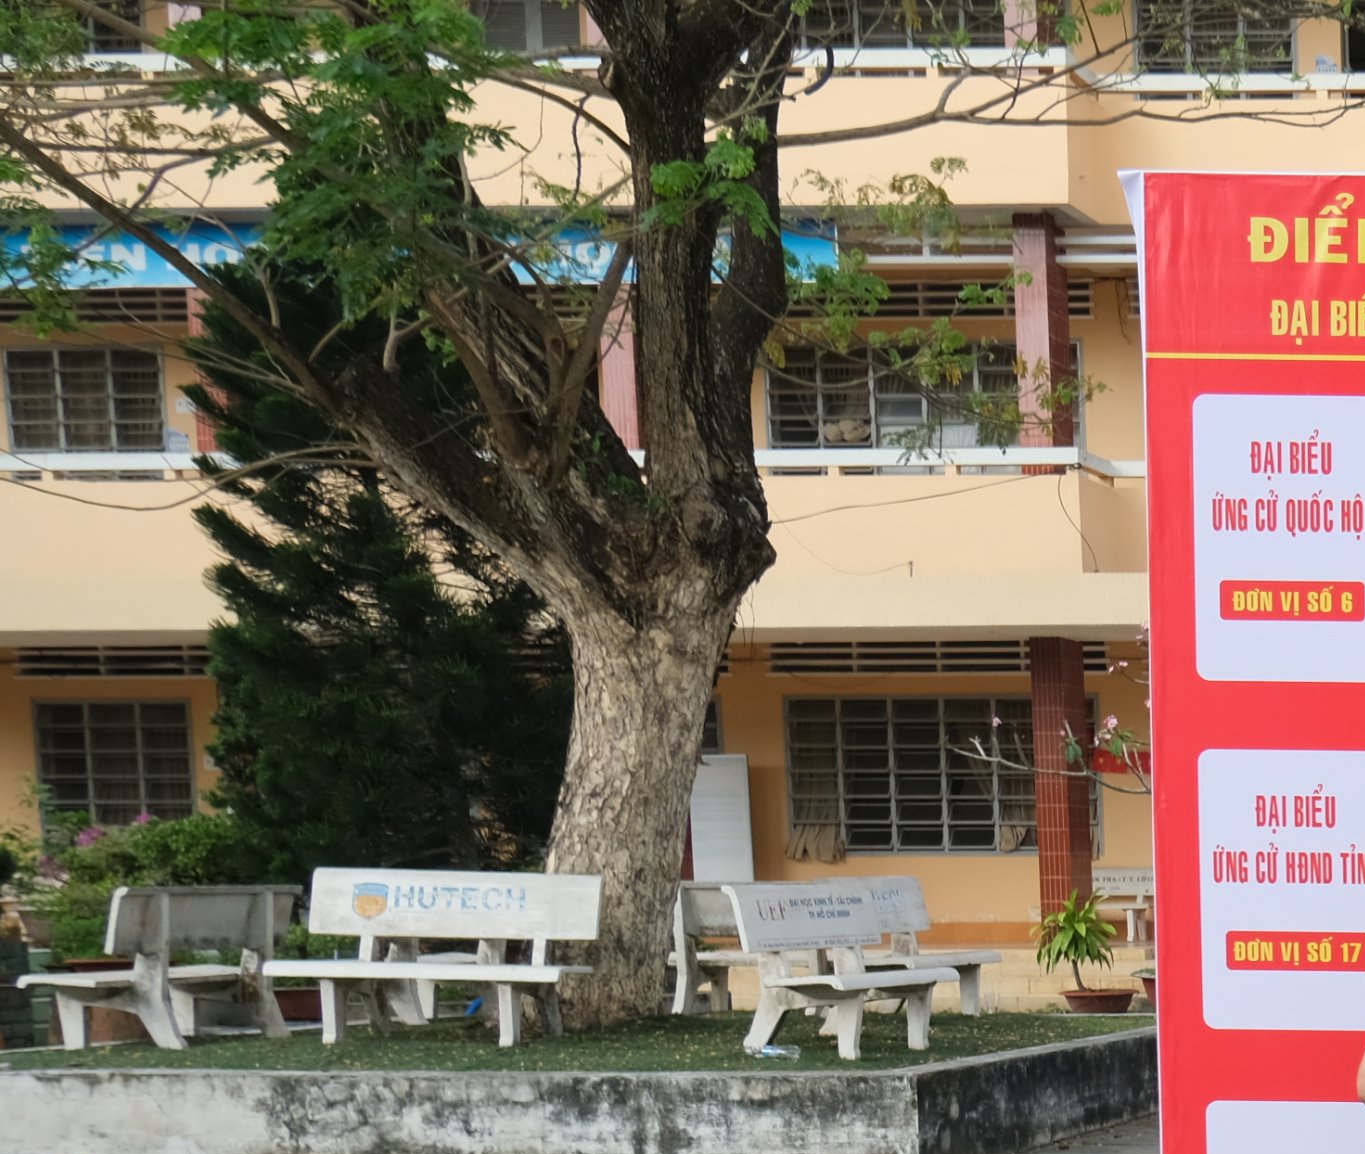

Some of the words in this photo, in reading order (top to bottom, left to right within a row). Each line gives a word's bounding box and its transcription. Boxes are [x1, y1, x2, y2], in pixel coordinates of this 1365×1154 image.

[1271, 300, 1321, 346] ĐẠI
[1250, 440, 1283, 481] ĐẠI
[1289, 429, 1333, 475] BIỂU
[1211, 491, 1248, 532] ỨNG
[1255, 489, 1279, 533] CỬ
[1286, 490, 1334, 537] QUỐC
[1232, 588, 1273, 613] ĐƠN
[1280, 592, 1300, 616] VỊ
[1307, 586, 1334, 614] SỐ
[1341, 592, 1354, 613] 6
[1255, 795, 1288, 834] ĐẠI
[1294, 783, 1337, 829] BIỂU
[1213, 845, 1248, 884] ỨNG
[1256, 843, 1279, 885] CỬ
[1286, 852, 1333, 885] HĐND
[393, 884, 527, 912] HUTECH
[1233, 938, 1274, 963] ĐƠN
[1280, 942, 1300, 966] VỊ
[1307, 936, 1333, 963] SỐ
[1341, 942, 1363, 963] 17
